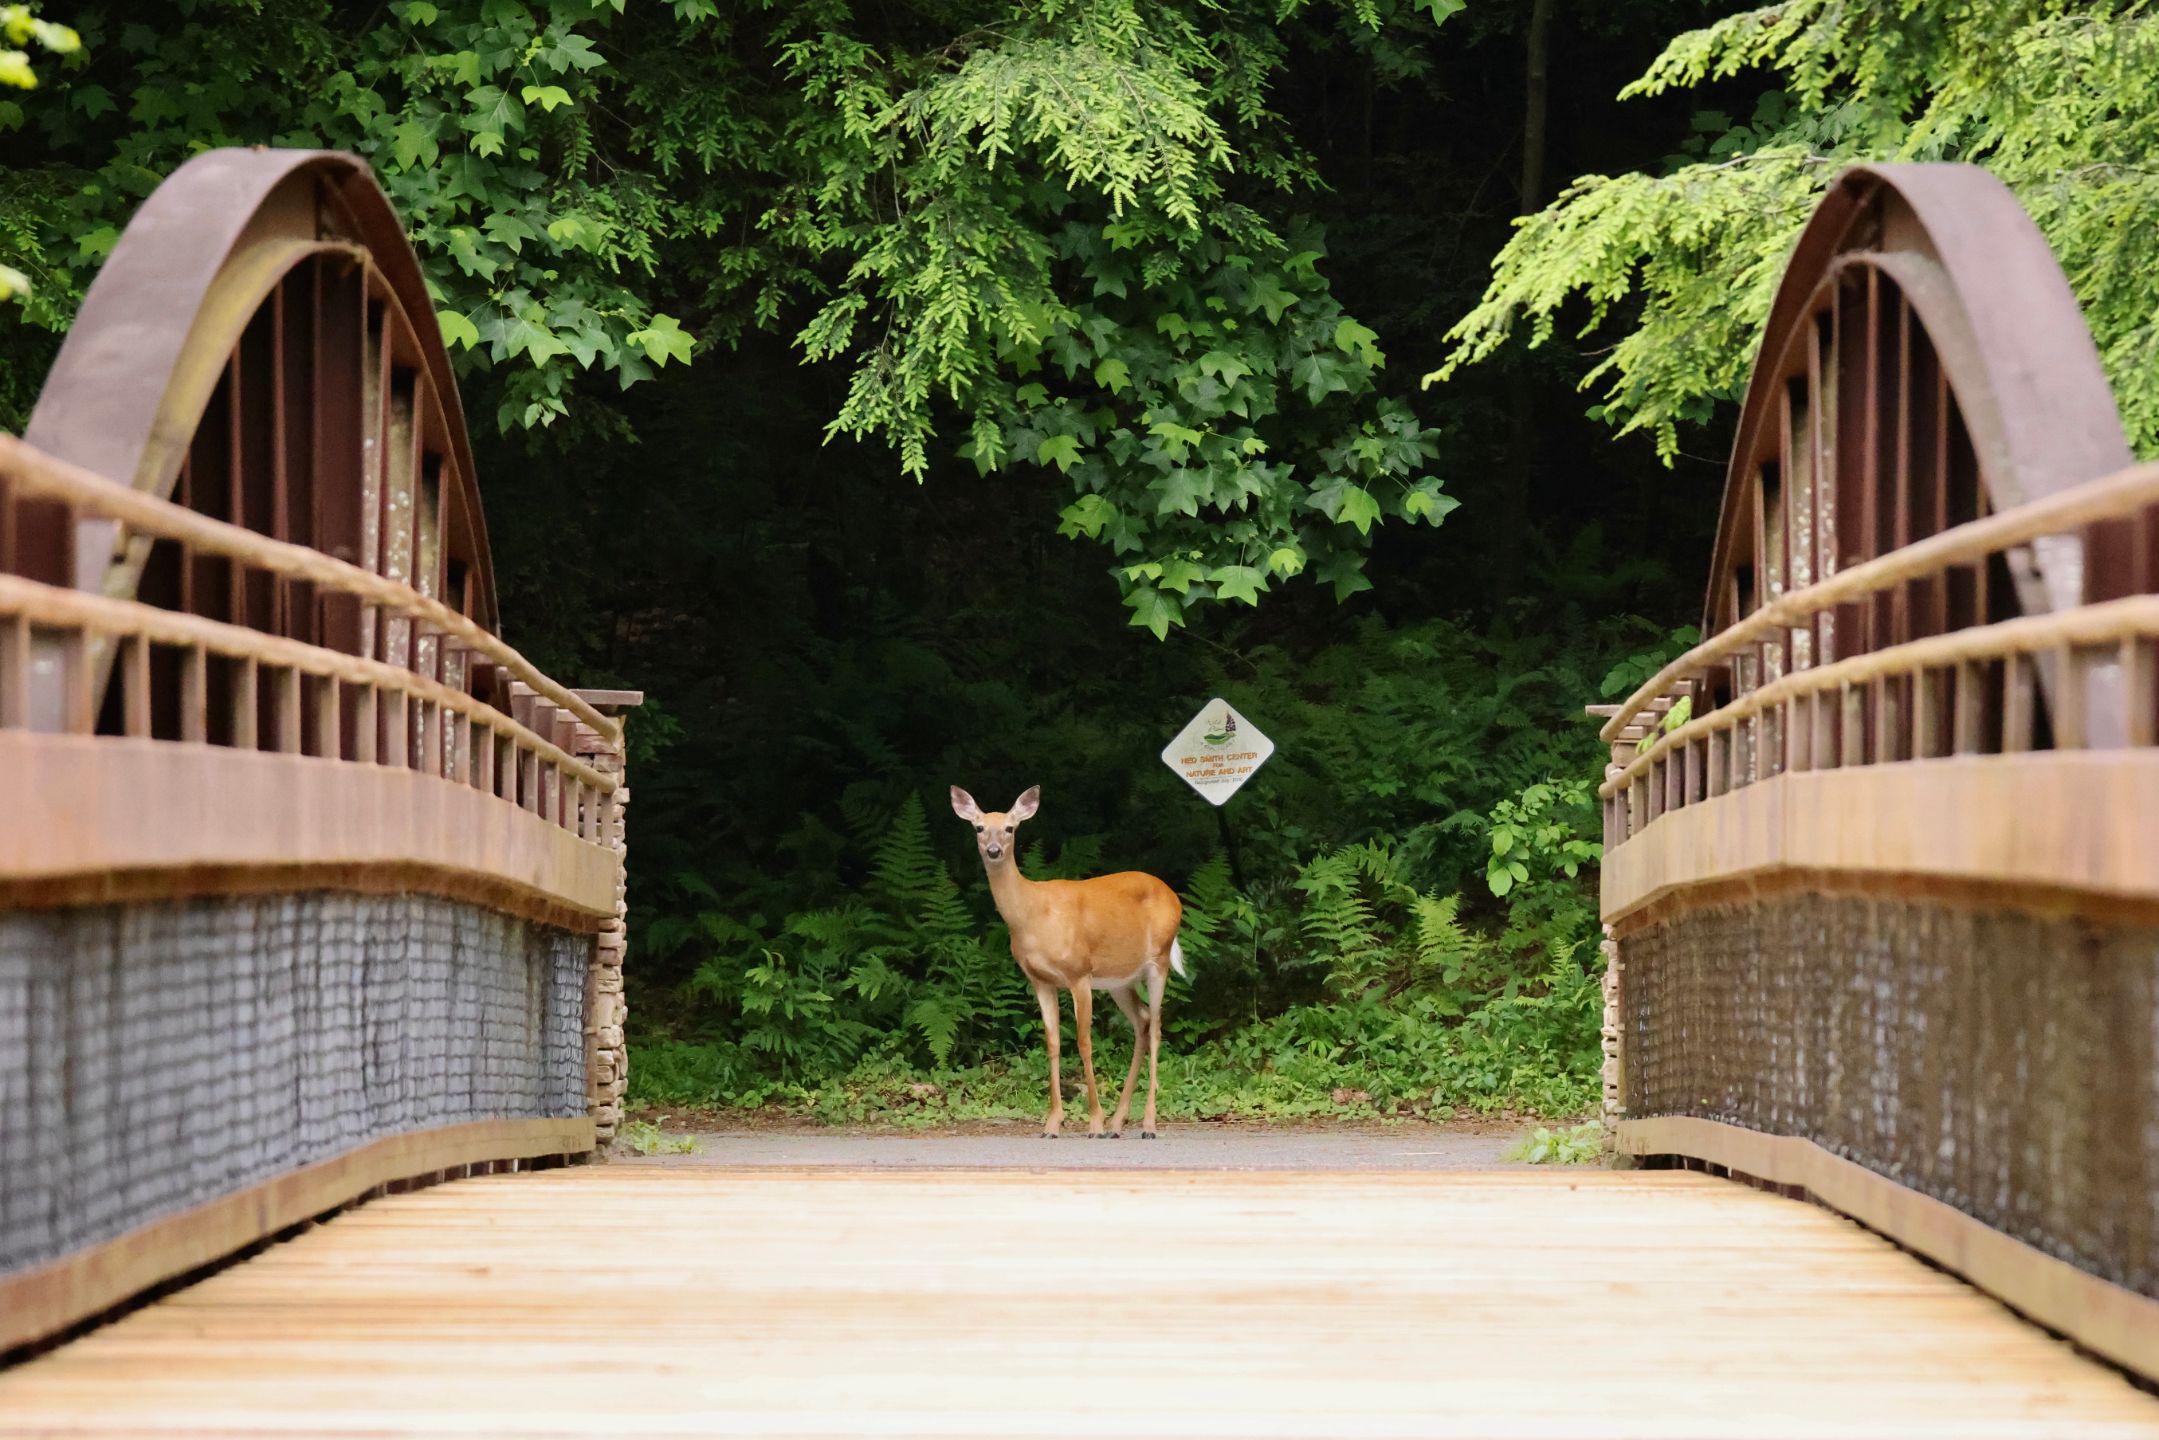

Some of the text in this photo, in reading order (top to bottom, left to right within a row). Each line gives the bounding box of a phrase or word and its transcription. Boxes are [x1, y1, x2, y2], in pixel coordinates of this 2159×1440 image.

[1200, 755, 1224, 763] SMITH
[1227, 752, 1258, 761] CENTER
[1186, 769, 1216, 777] NATURE
[1237, 766, 1253, 774] ART
